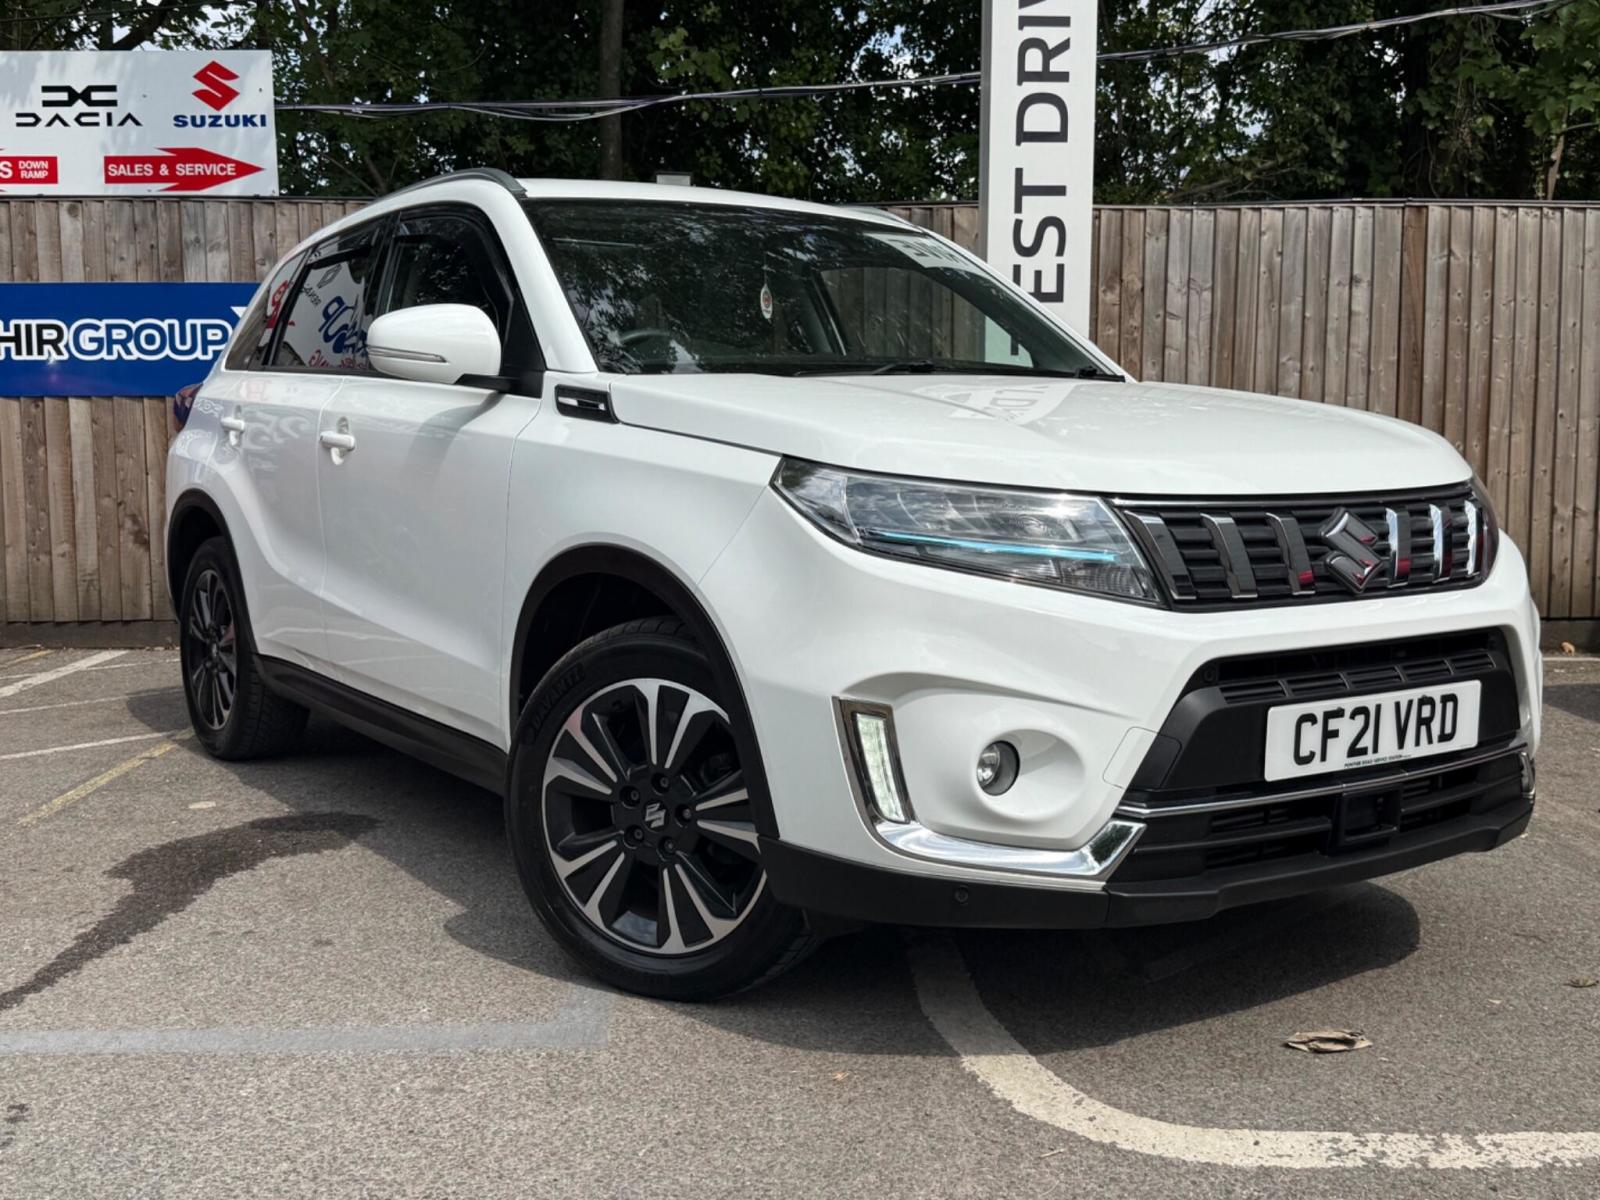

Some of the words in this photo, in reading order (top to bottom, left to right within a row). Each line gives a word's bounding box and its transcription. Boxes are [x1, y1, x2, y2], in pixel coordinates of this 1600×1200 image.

[15, 112, 143, 127] DACIA
[173, 114, 267, 128] SUZUKI
[18, 160, 49, 170] DOWN
[107, 163, 153, 176] SALES
[159, 163, 169, 176] &
[175, 163, 236, 176] SERVICE
[20, 170, 49, 179] RAMP
[1292, 703, 1382, 767] CF21
[1394, 692, 1459, 750] VRD
